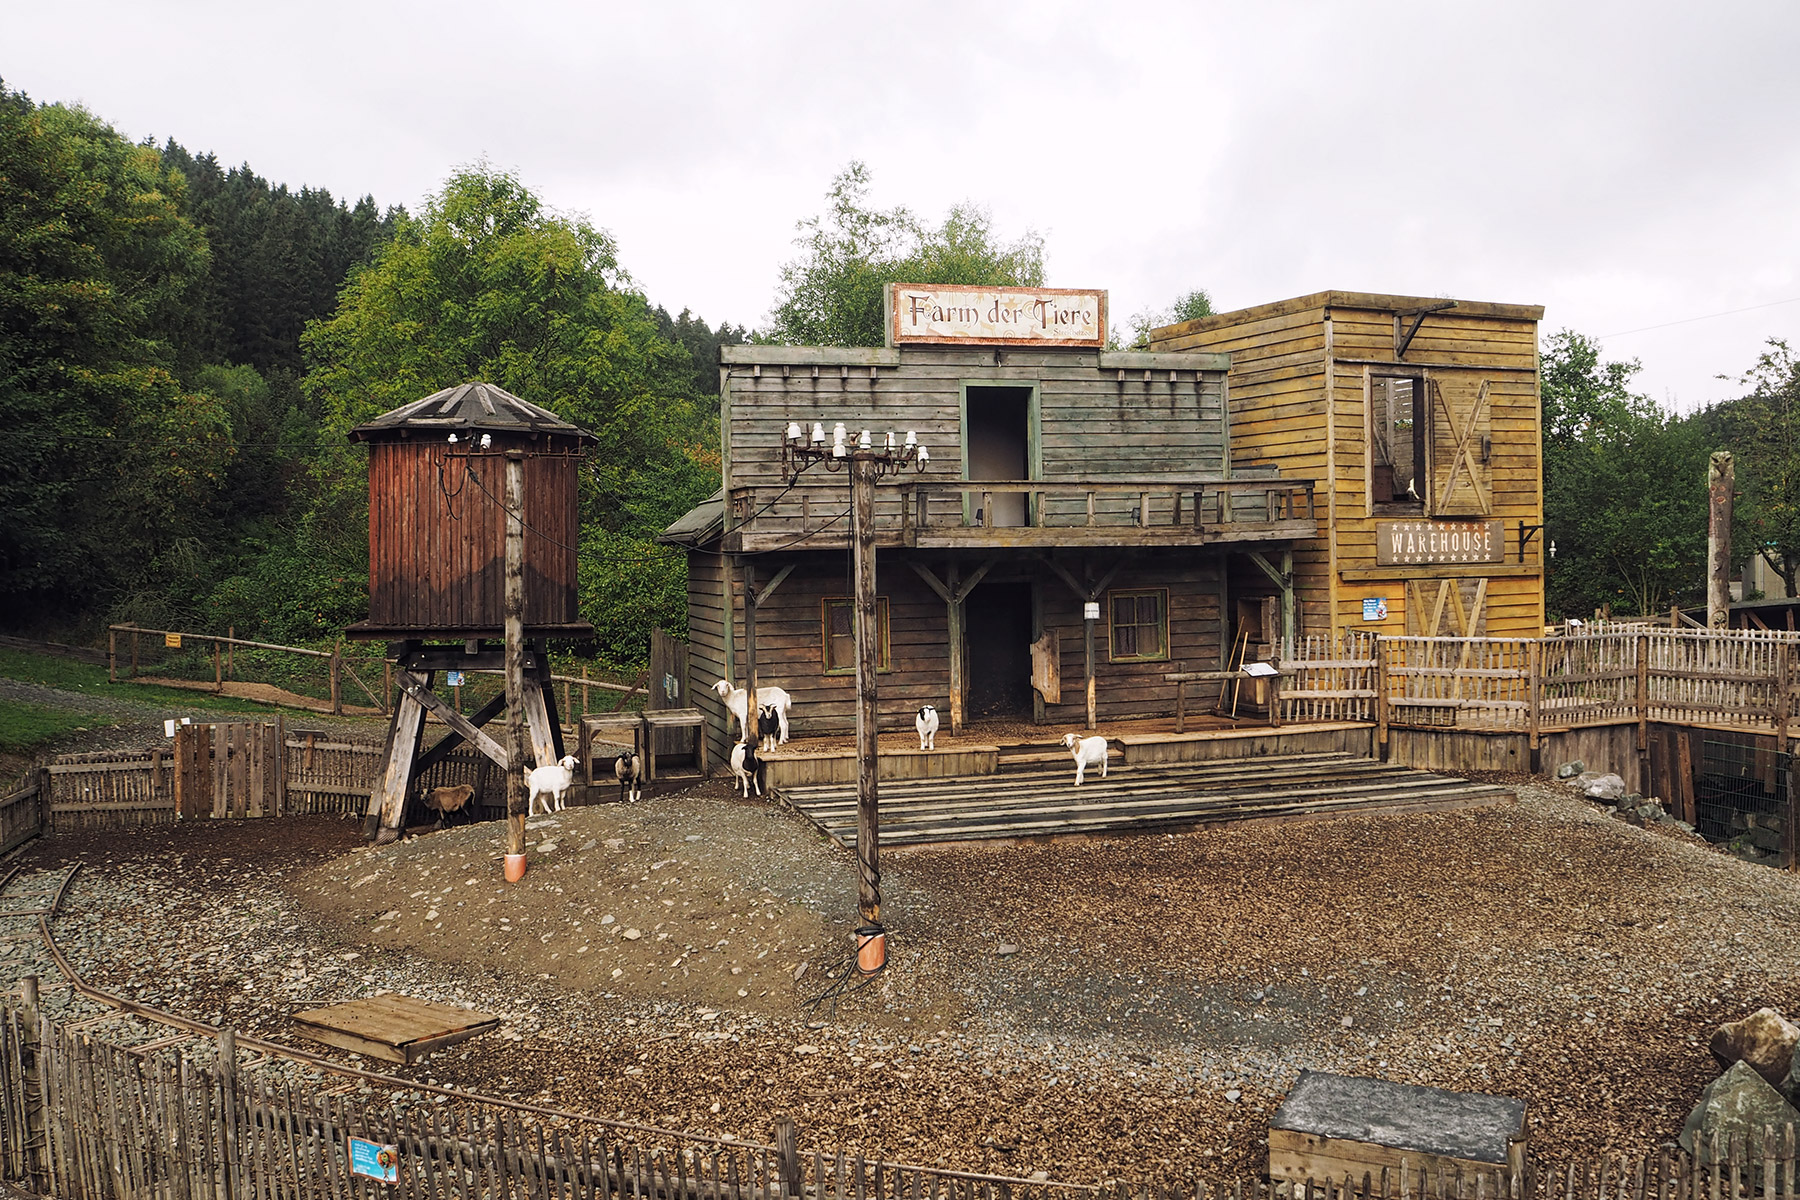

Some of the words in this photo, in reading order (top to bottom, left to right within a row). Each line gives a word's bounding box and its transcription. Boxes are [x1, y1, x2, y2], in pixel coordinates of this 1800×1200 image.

[907, 294, 979, 327] Farm
[987, 298, 1023, 324] der
[1032, 298, 1092, 330] Tiere
[1391, 531, 1492, 554] WAREHOUSE
